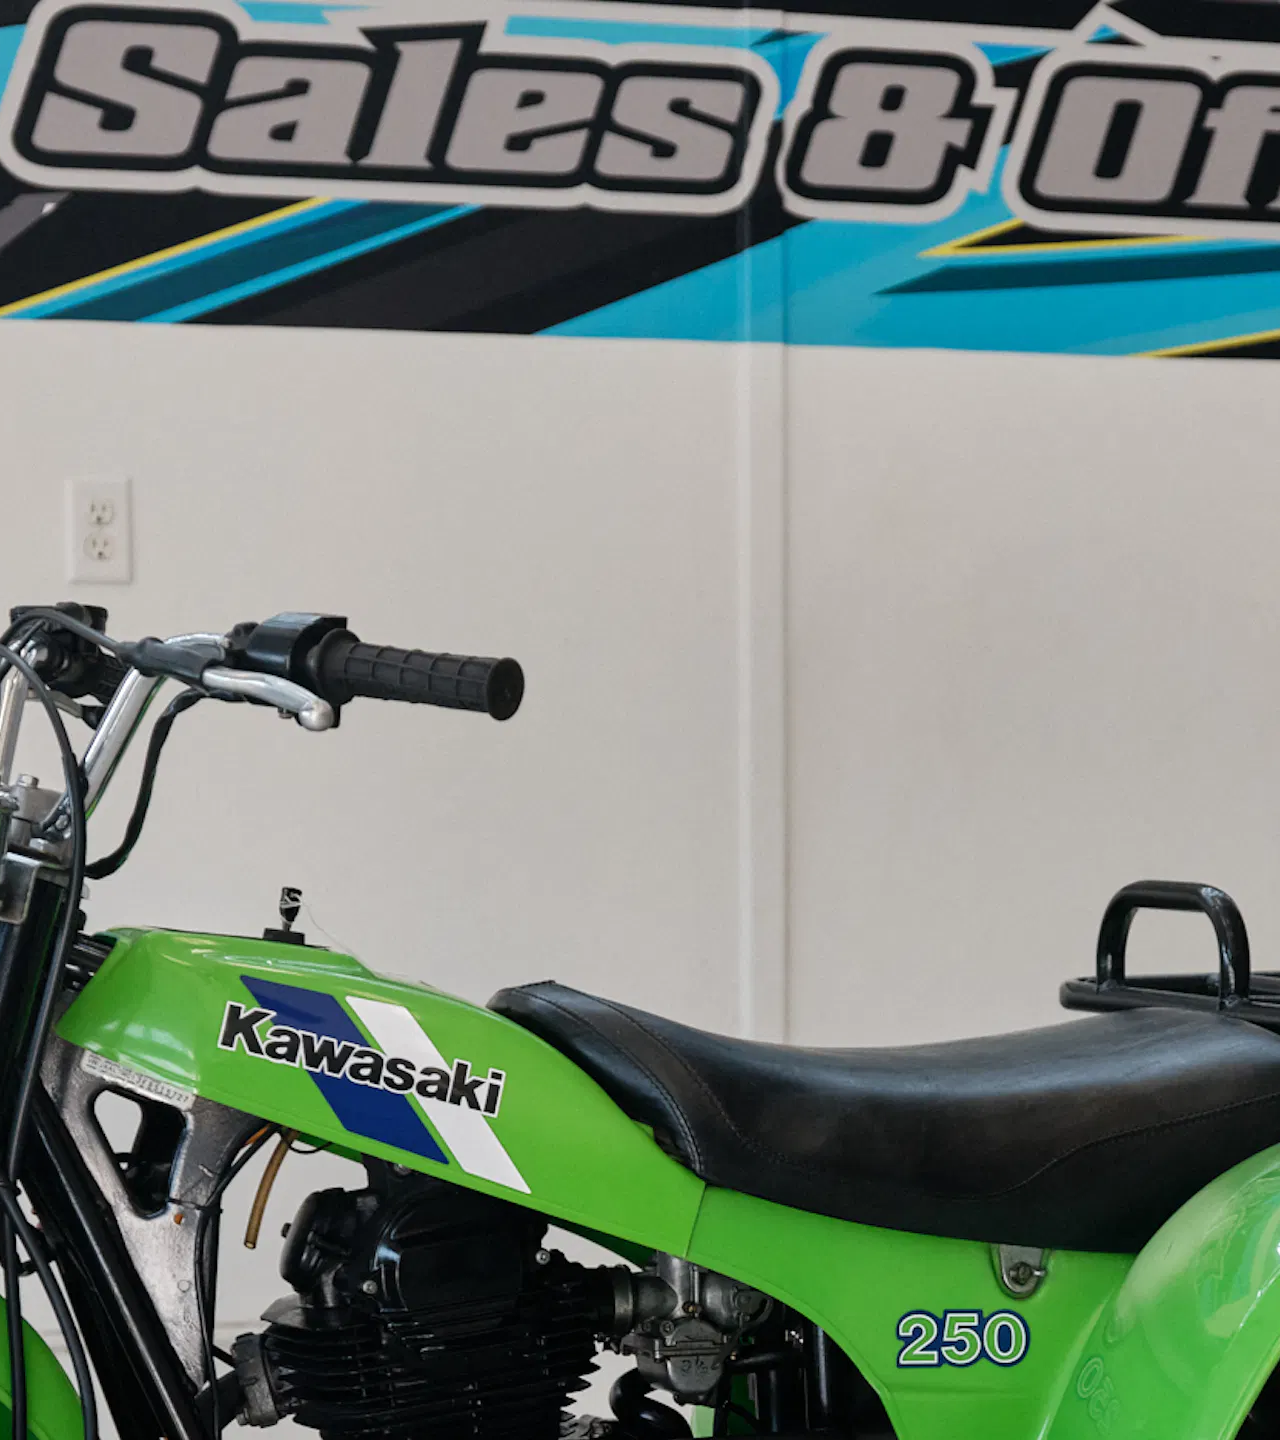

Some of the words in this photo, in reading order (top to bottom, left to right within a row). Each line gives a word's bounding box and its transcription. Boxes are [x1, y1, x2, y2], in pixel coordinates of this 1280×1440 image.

[26, 8, 745, 182] Sales
[802, 62, 978, 204] &
[218, 1001, 506, 1118] Kawasaki
[896, 1309, 1031, 1368] 250
